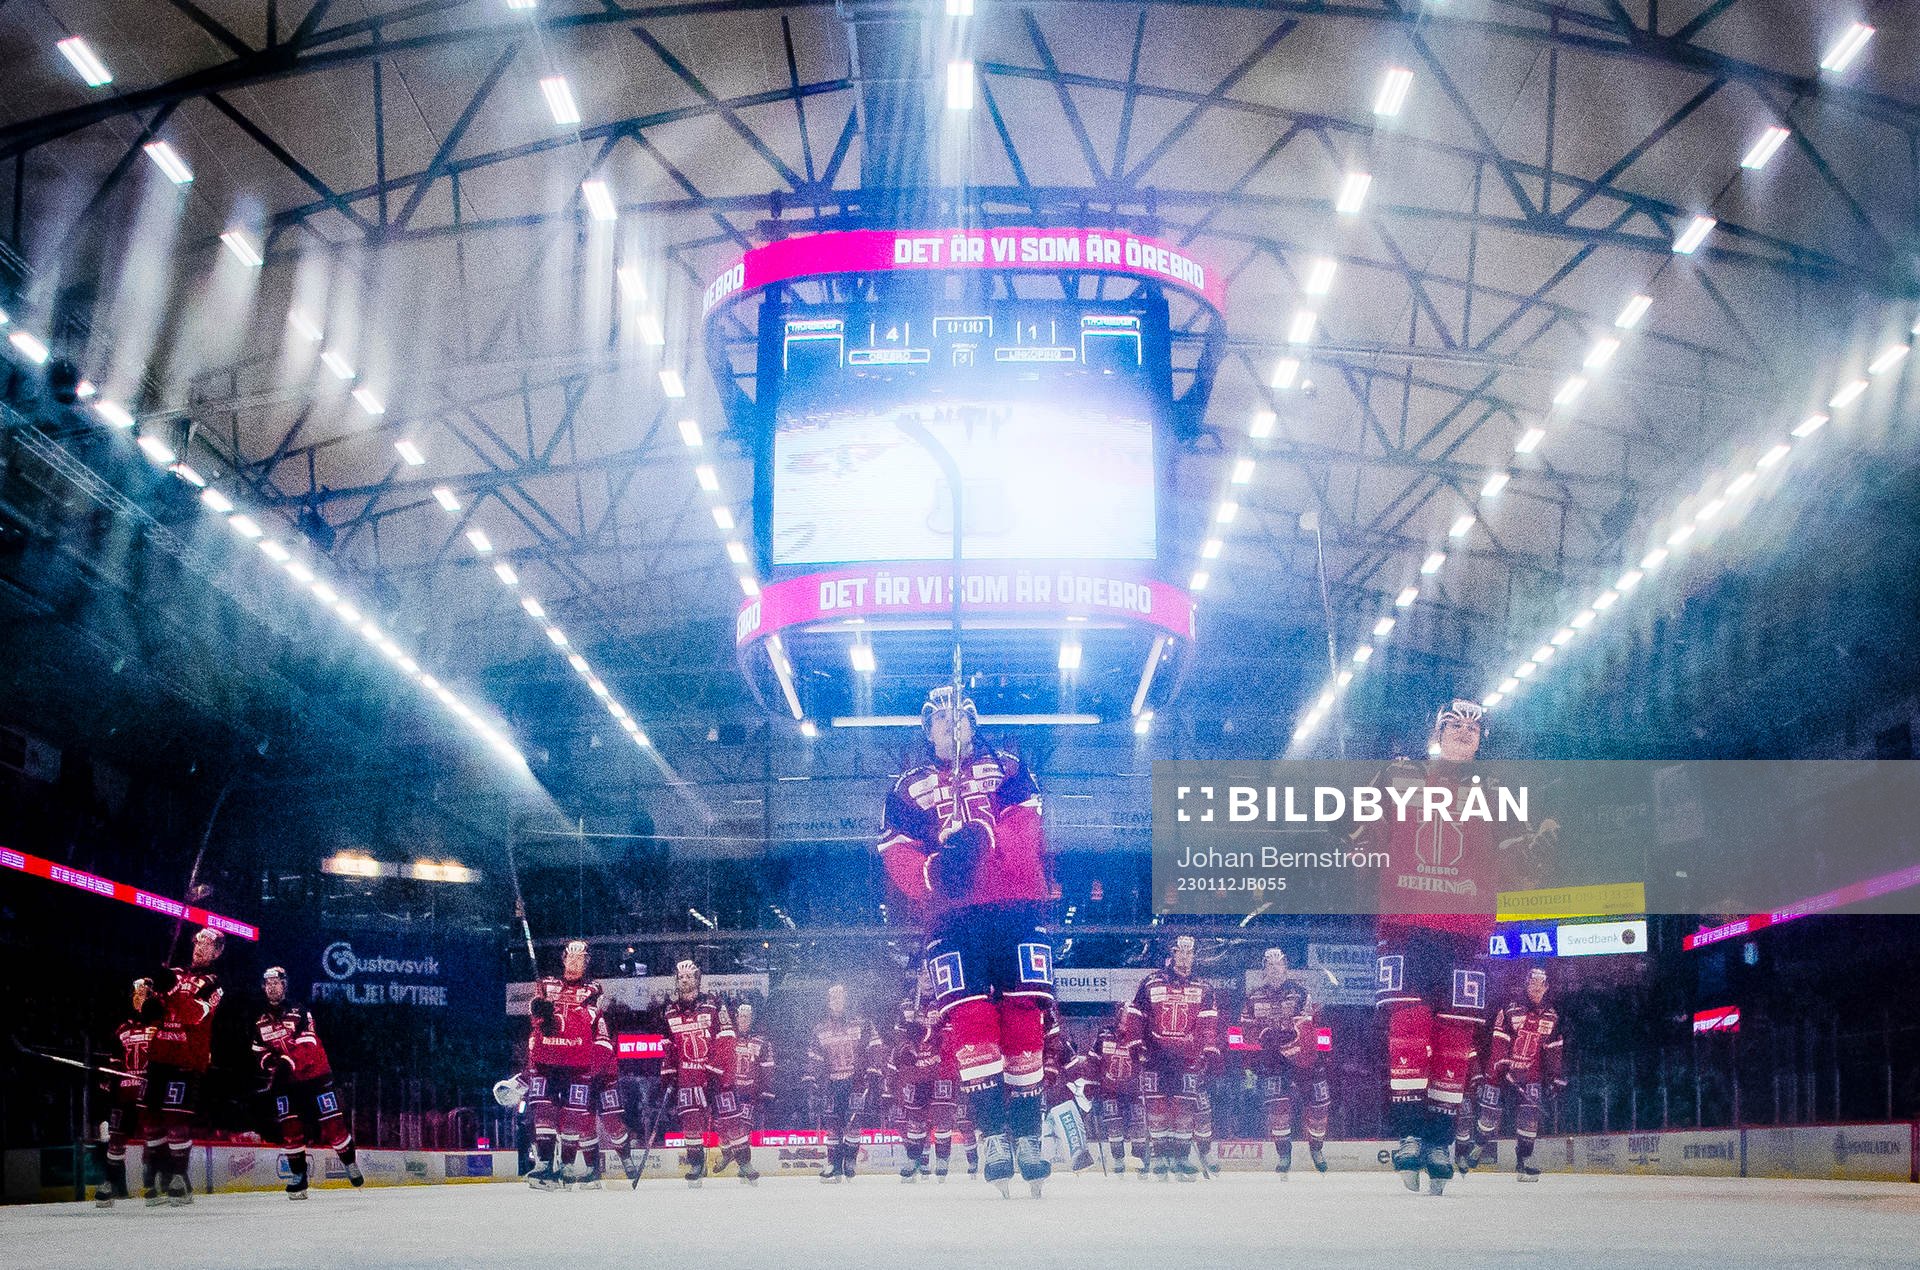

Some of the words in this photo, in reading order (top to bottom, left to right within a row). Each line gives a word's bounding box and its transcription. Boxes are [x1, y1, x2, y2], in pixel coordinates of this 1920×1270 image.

[894, 238, 945, 264] DET
[951, 235, 985, 263] ÄR
[991, 237, 1016, 263] VI
[1021, 237, 1081, 263] SOM
[1086, 235, 1121, 265] ÄR
[1125, 238, 1205, 290] ÖREBRO
[885, 327, 899, 342] 4
[1028, 325, 1038, 340] 1
[819, 578, 868, 611] DET
[875, 571, 911, 606] ÄR
[917, 576, 943, 604] VI
[1015, 570, 1052, 604] ÄR
[1057, 571, 1153, 614] ÖREBRO
[1416, 863, 1459, 876] ÖREBRO
[1397, 875, 1458, 893] BEHRN
[1519, 932, 1553, 954] NA
[1567, 934, 1619, 946] Swedbank
[322, 941, 439, 980] Gustavsvik
[1052, 976, 1107, 988] ERCULES
